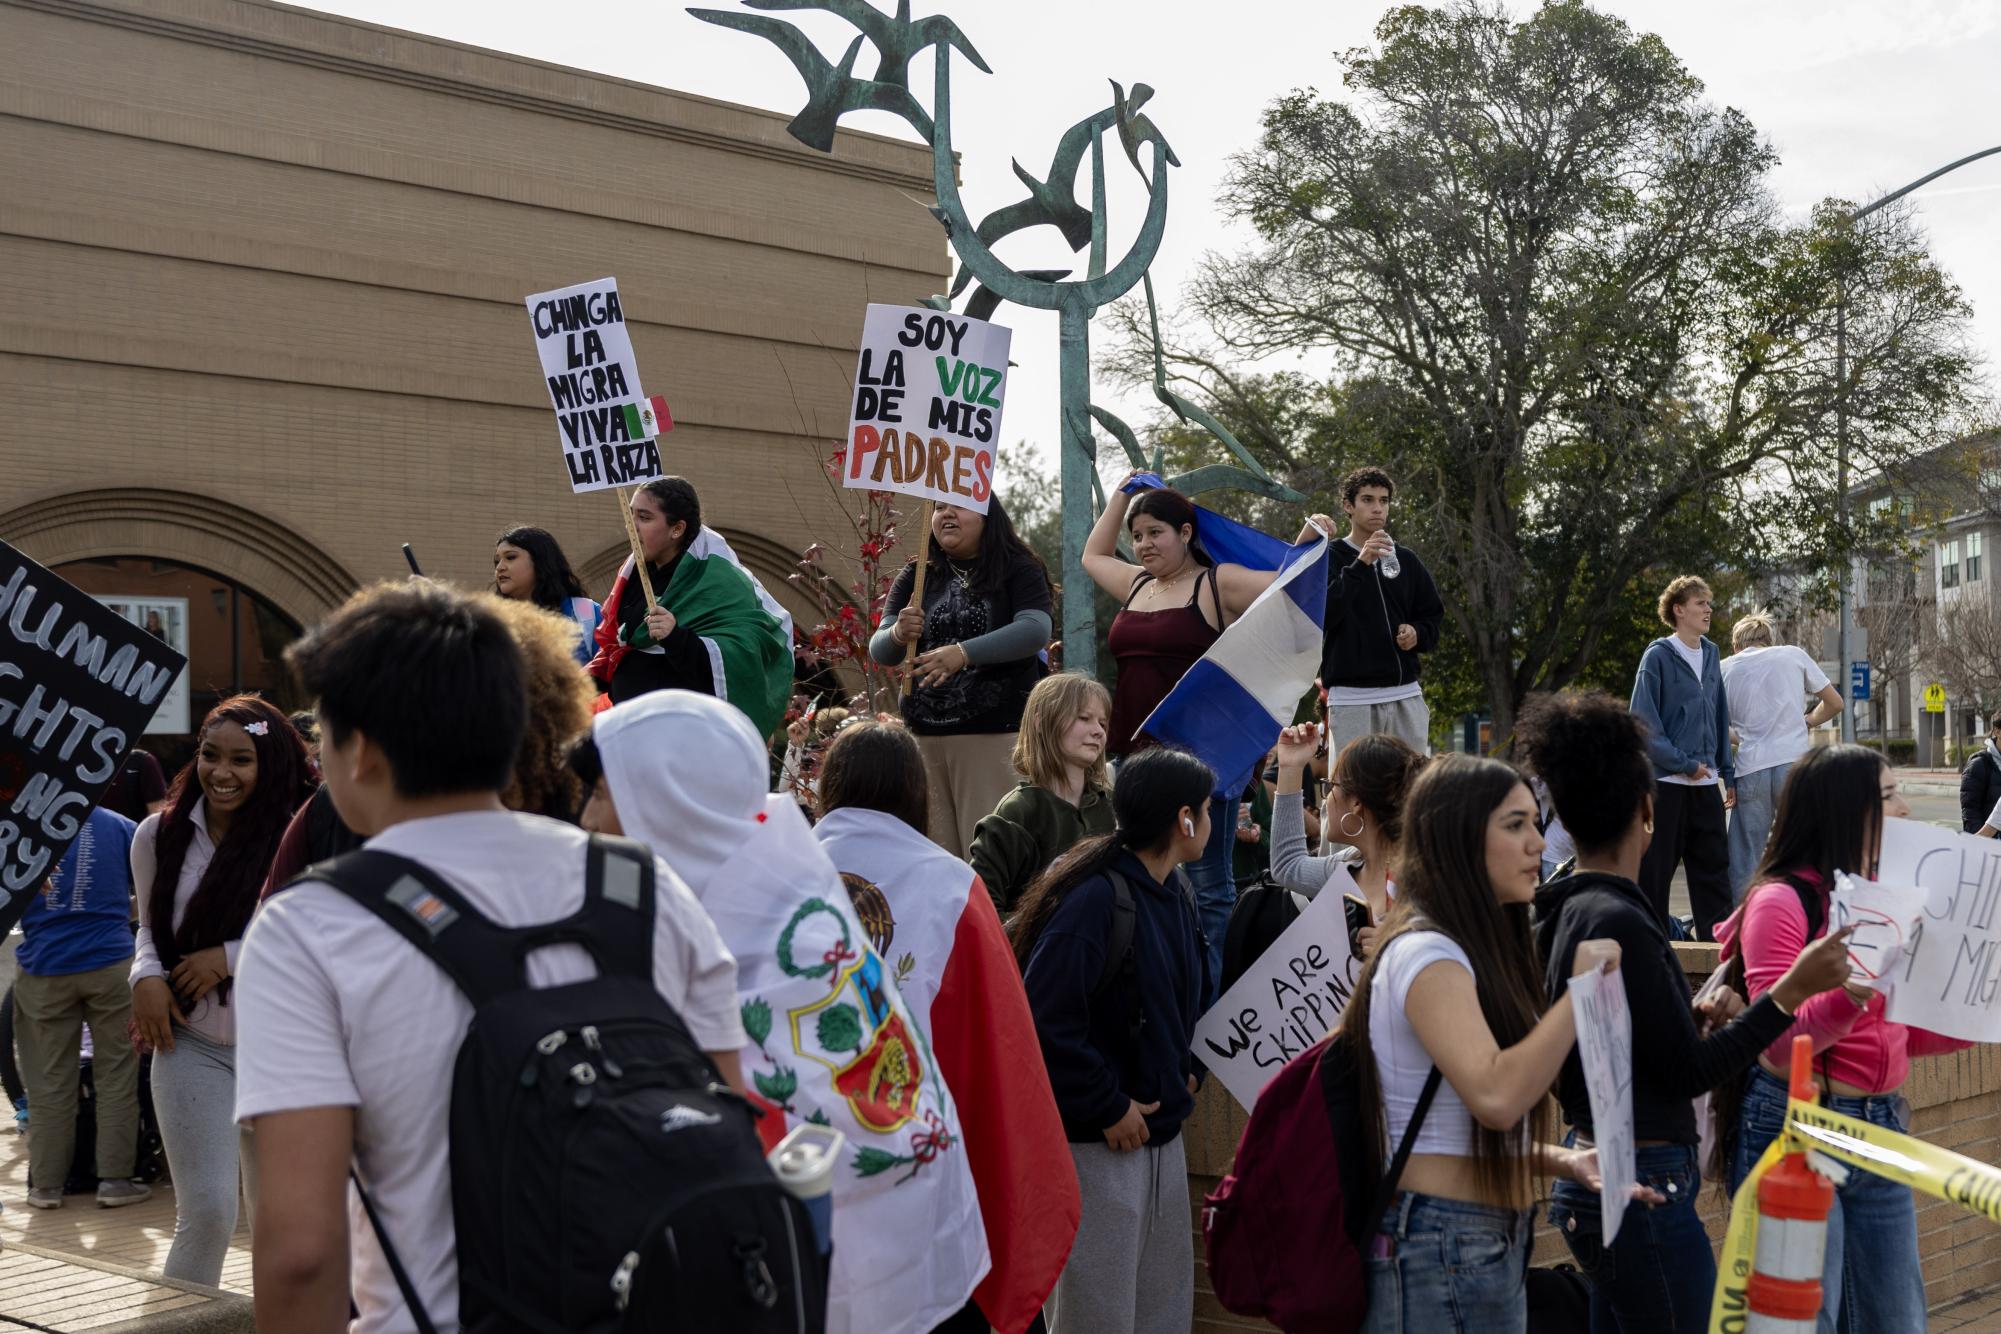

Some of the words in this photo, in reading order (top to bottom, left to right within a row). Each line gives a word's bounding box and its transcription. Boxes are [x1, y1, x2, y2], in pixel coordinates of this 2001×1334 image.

[533, 291, 623, 339] CHINGA
[898, 313, 968, 356] SOY
[566, 329, 606, 370] LA
[548, 362, 629, 410] MIGRA
[859, 348, 905, 387] LA
[936, 355, 1002, 409] VOZ
[559, 404, 630, 448] VIVA
[855, 386, 905, 422] DE
[928, 396, 993, 443] MIS
[566, 449, 600, 485] LA
[600, 441, 663, 485] RAZA
[850, 424, 991, 502] PADRES
[0, 662, 126, 784] HTS
[1915, 847, 2001, 931] CHI
[1939, 933, 2001, 1010] MIG
